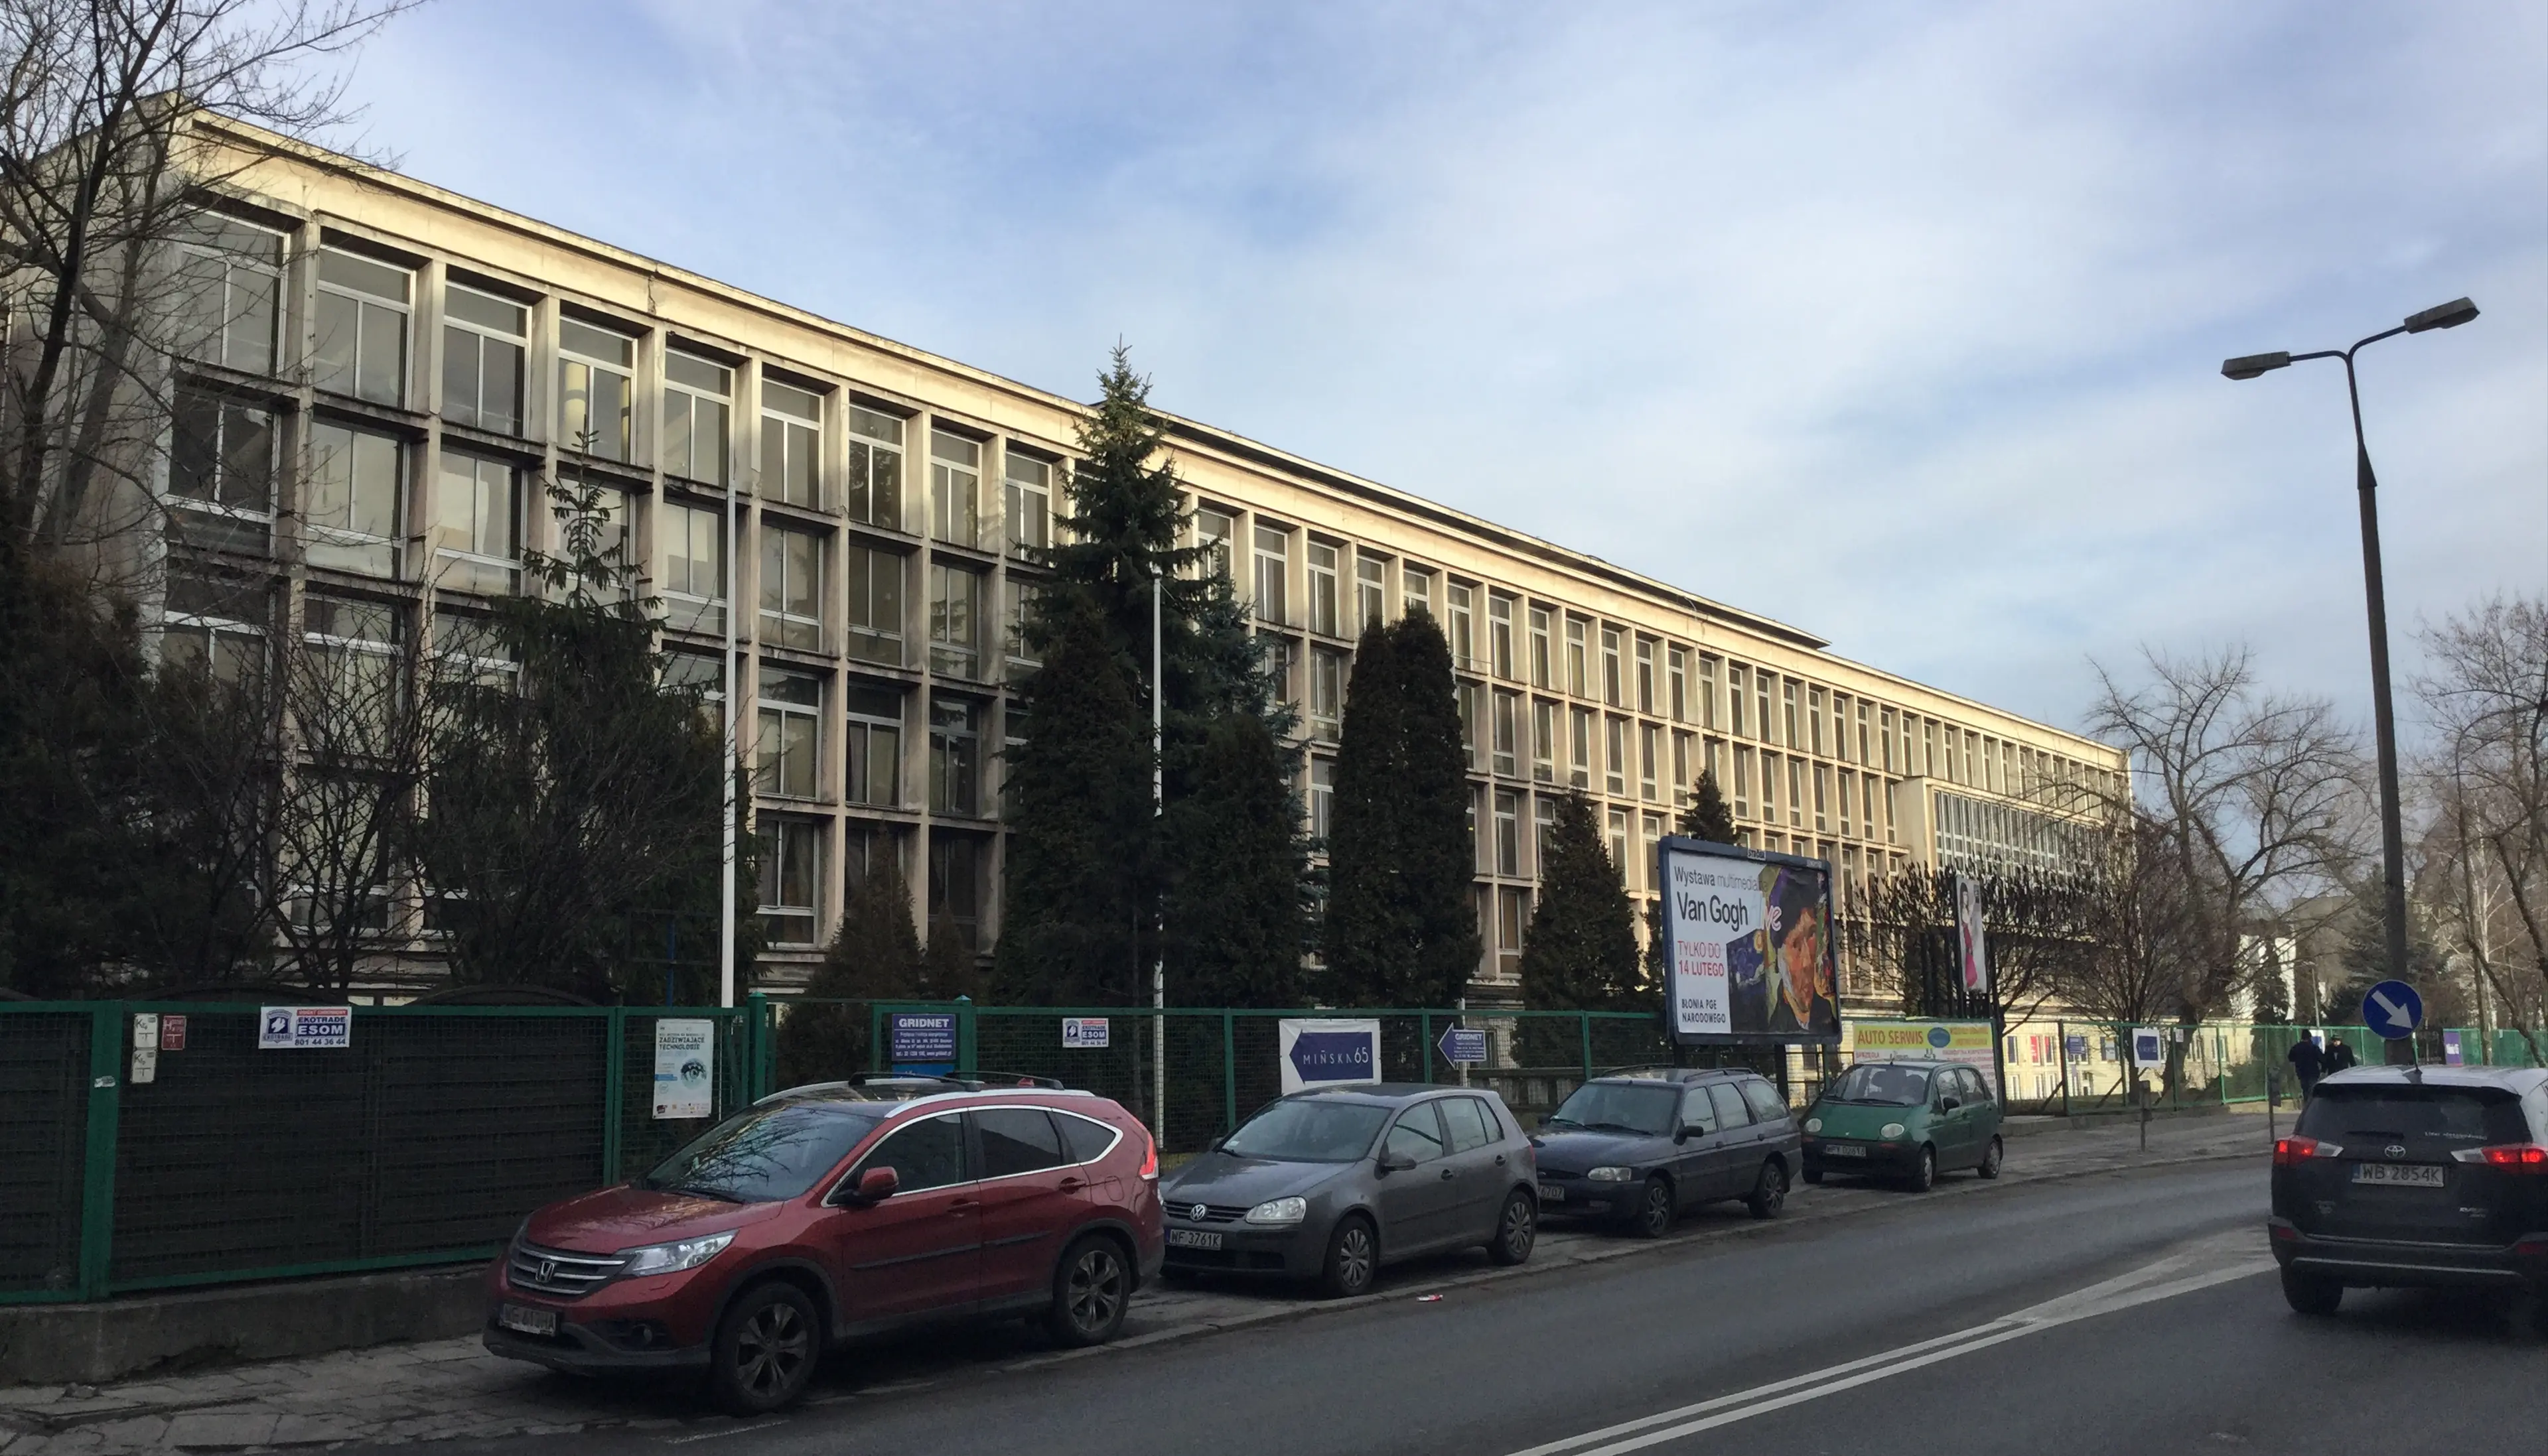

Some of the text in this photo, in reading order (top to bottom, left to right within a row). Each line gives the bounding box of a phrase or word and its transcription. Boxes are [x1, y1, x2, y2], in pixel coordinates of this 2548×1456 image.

[1674, 865, 1716, 888] Wystawa
[1677, 892, 1707, 922] Van
[1710, 894, 1748, 932] Gogh
[1677, 941, 1721, 959] TYLKO DO
[1679, 961, 1725, 978] 14 LUTEGO
[1681, 998, 1717, 1010] BŁONIA PGE
[898, 1018, 950, 1028] GRIDNET
[1682, 1012, 1726, 1024] NARODOWEGO
[298, 1025, 343, 1035] ESOM
[1858, 1029, 1924, 1045] AUTO SERWIS
[1354, 1047, 1369, 1064] 65
[2362, 1165, 2440, 1182] WB 2854K
[1172, 1231, 1220, 1247] WF 3761K
